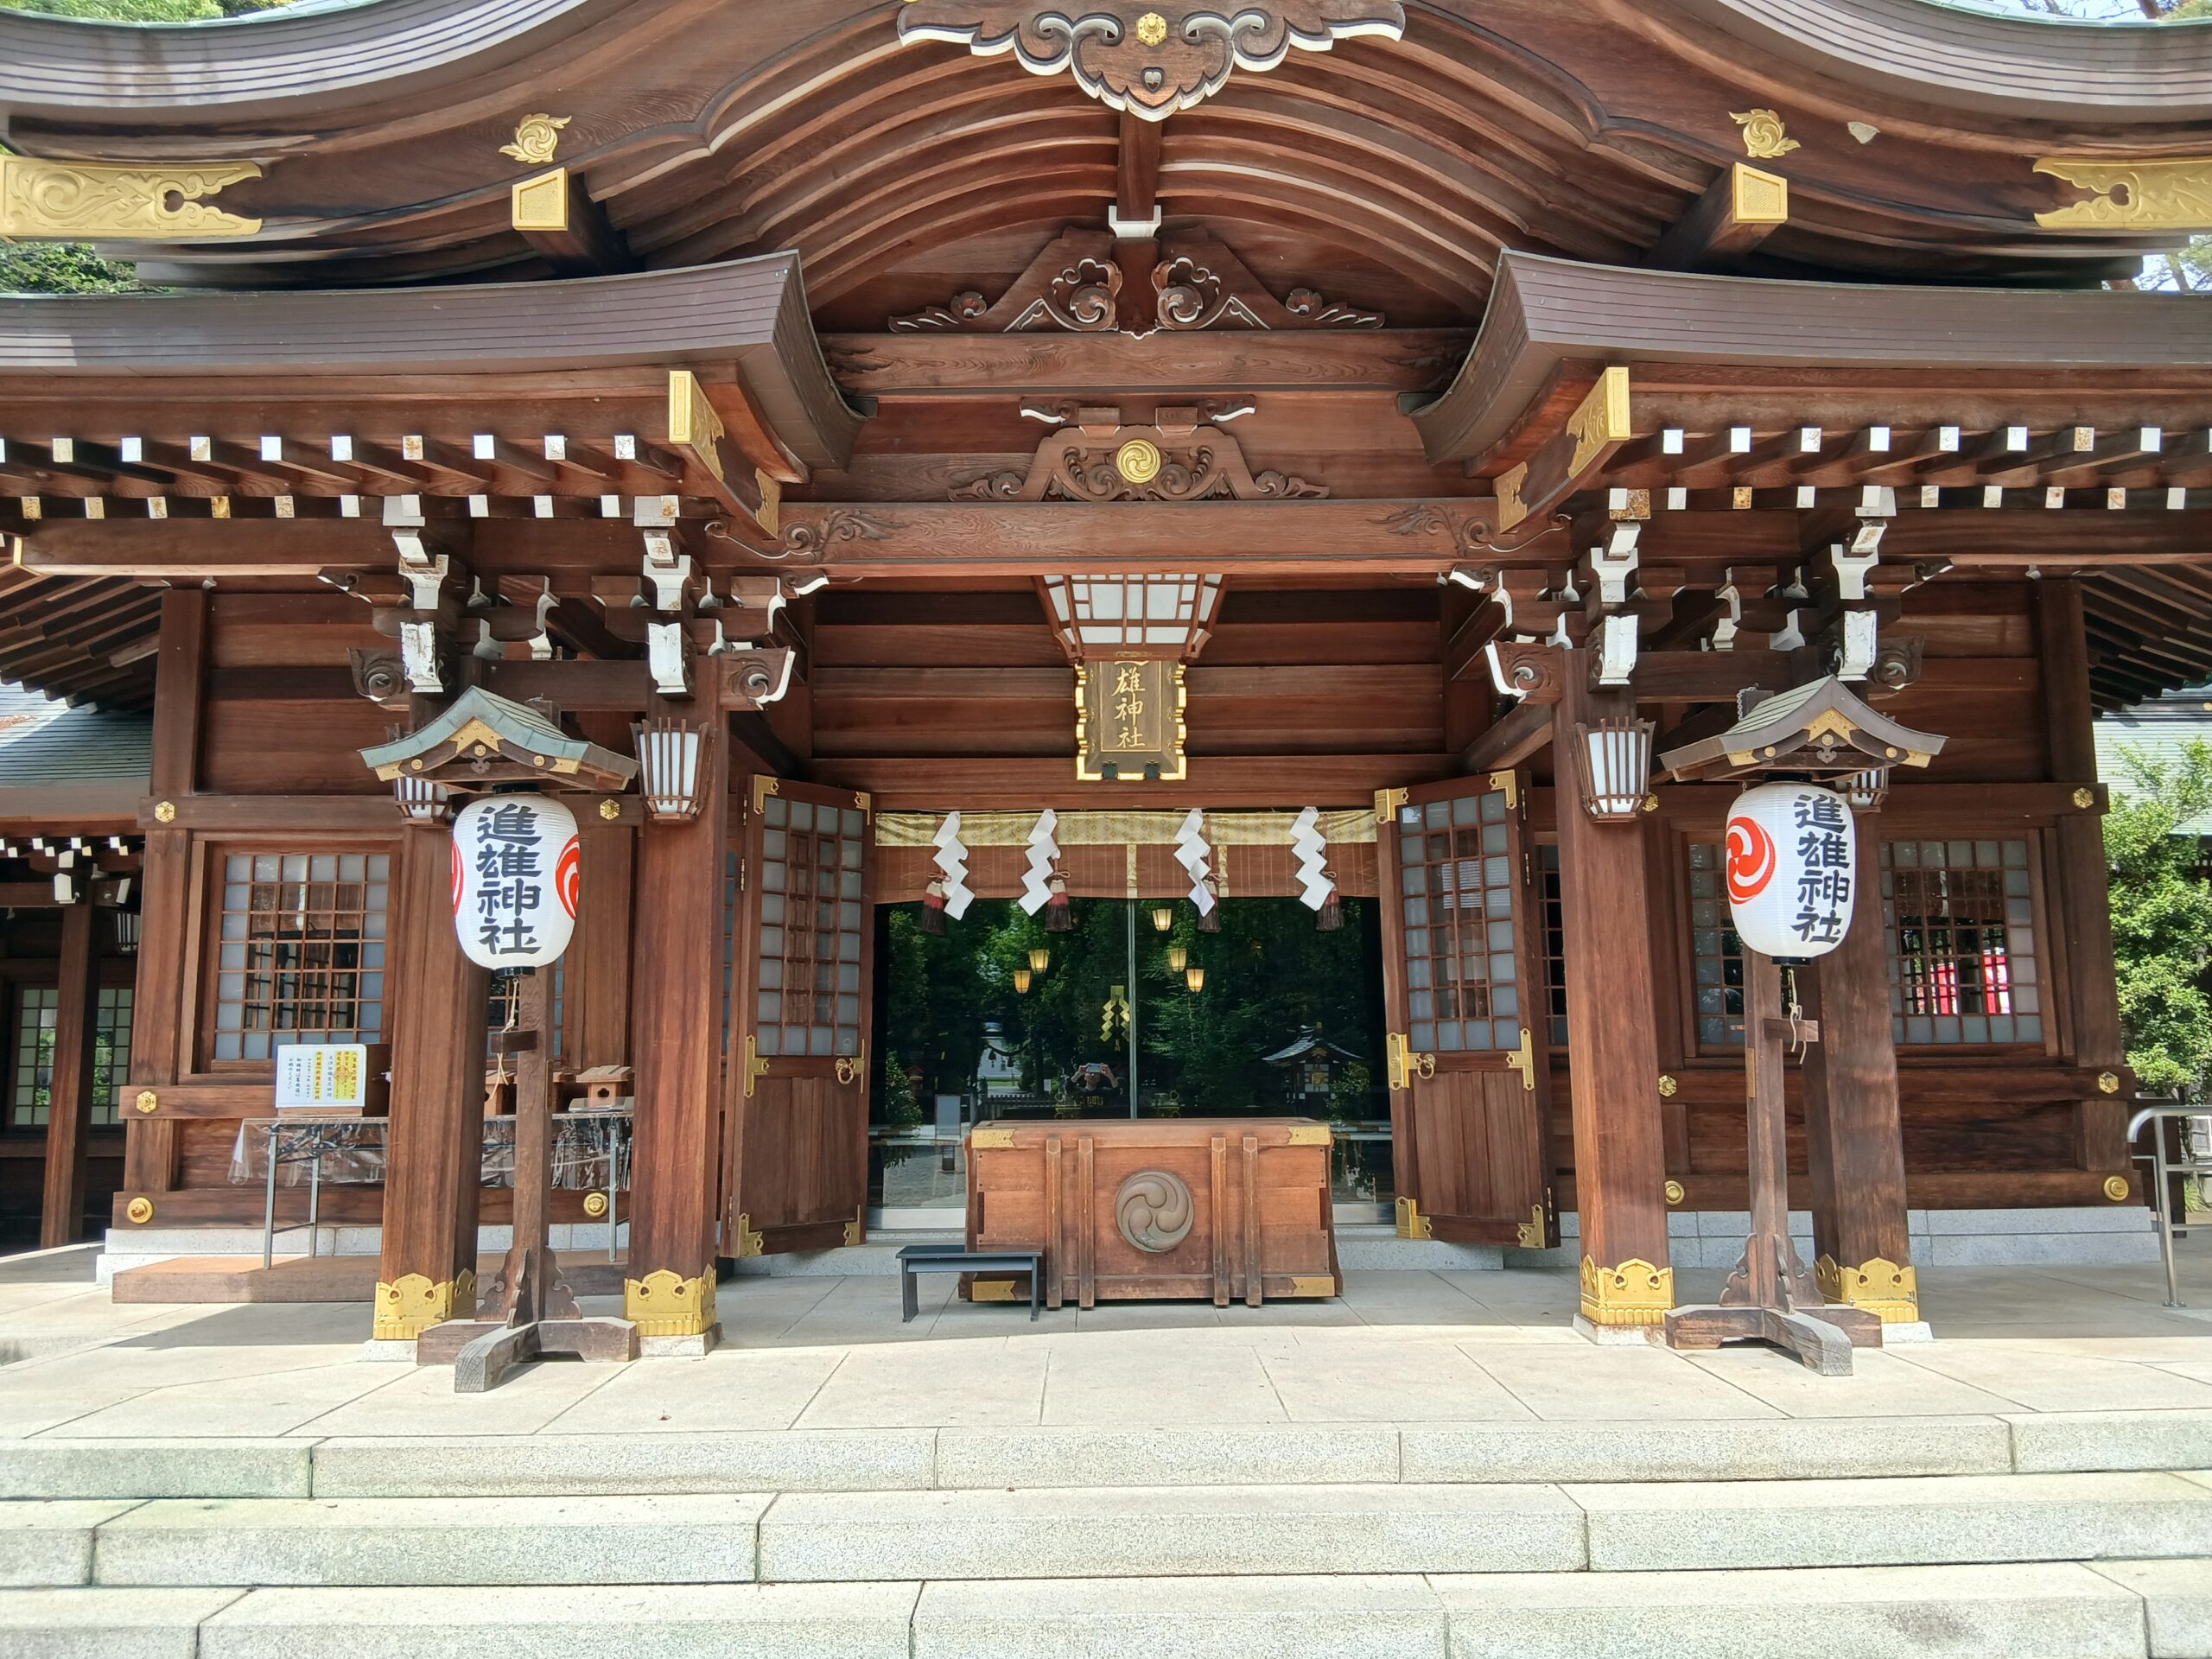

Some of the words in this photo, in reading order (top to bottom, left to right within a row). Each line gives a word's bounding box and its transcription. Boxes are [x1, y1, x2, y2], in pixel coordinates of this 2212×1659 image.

[1111, 661, 1149, 748] 雄神社
[476, 804, 543, 955] 進雄神社
[1790, 794, 1850, 944] 進雄神社
